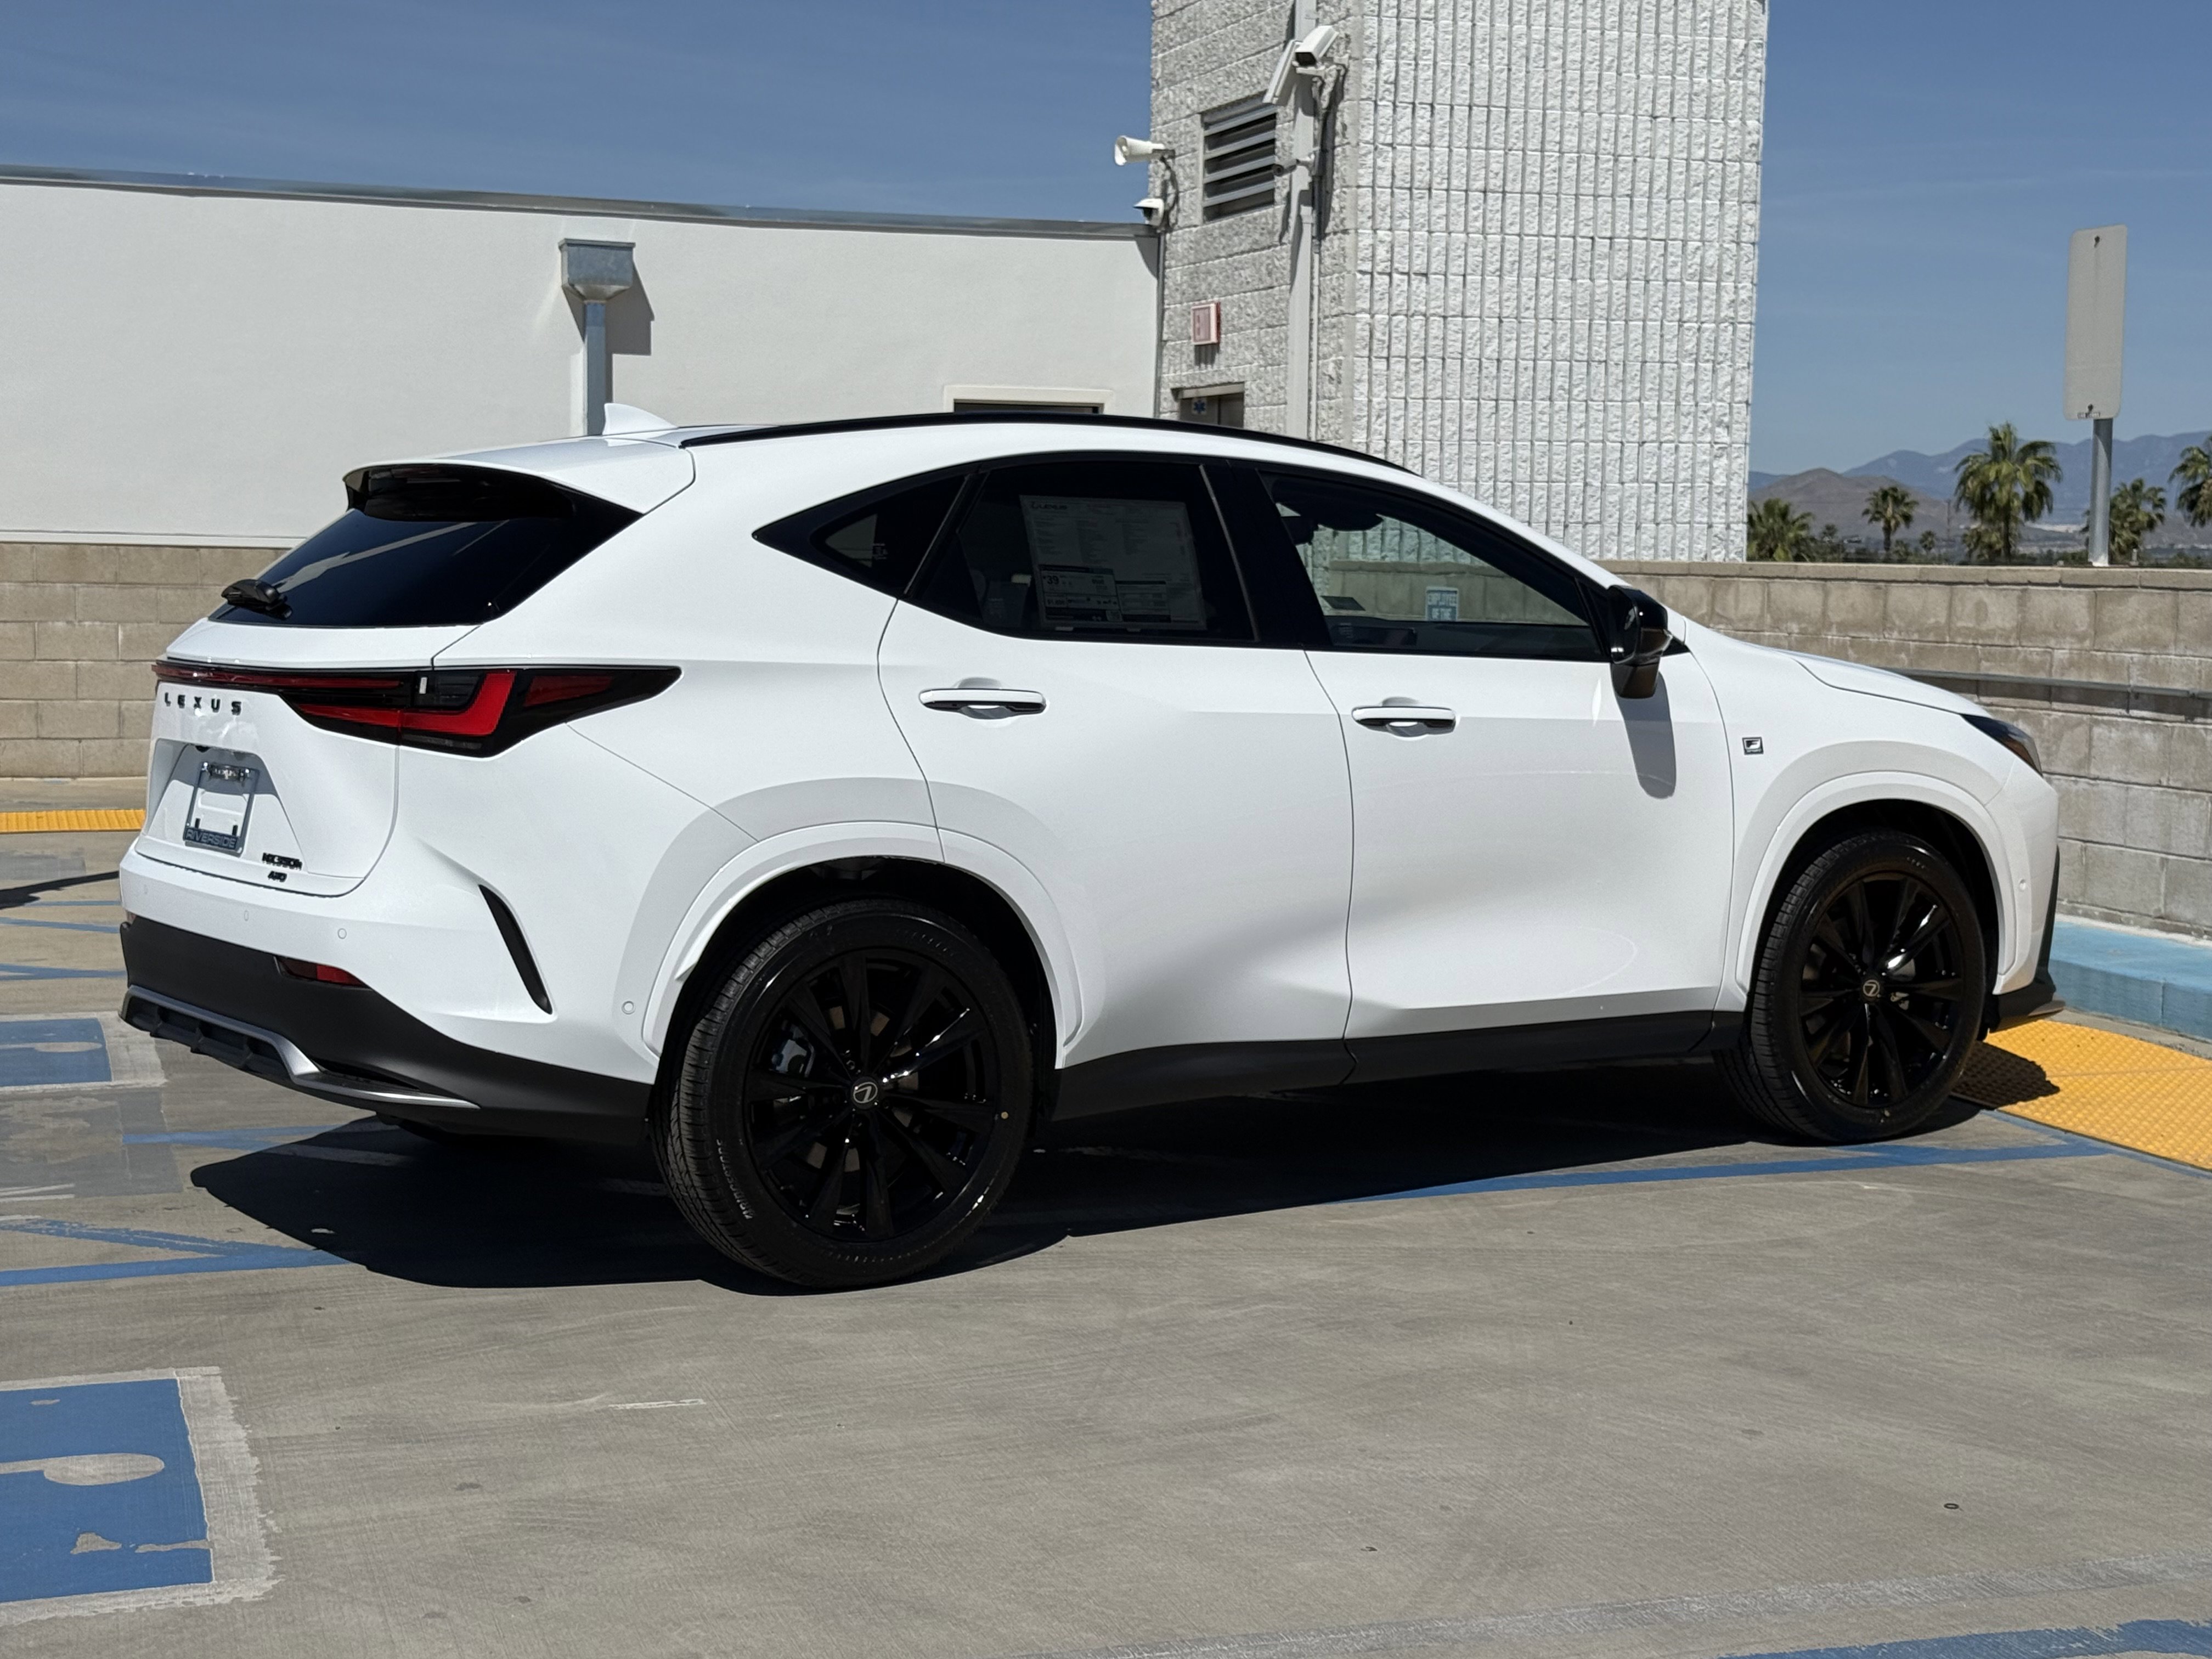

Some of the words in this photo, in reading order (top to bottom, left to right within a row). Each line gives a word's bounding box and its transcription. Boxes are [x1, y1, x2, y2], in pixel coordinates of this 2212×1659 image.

[1047, 575, 1059, 585] 39
[165, 692, 242, 716] LEXUS
[186, 829, 237, 849] RIVERSIDE
